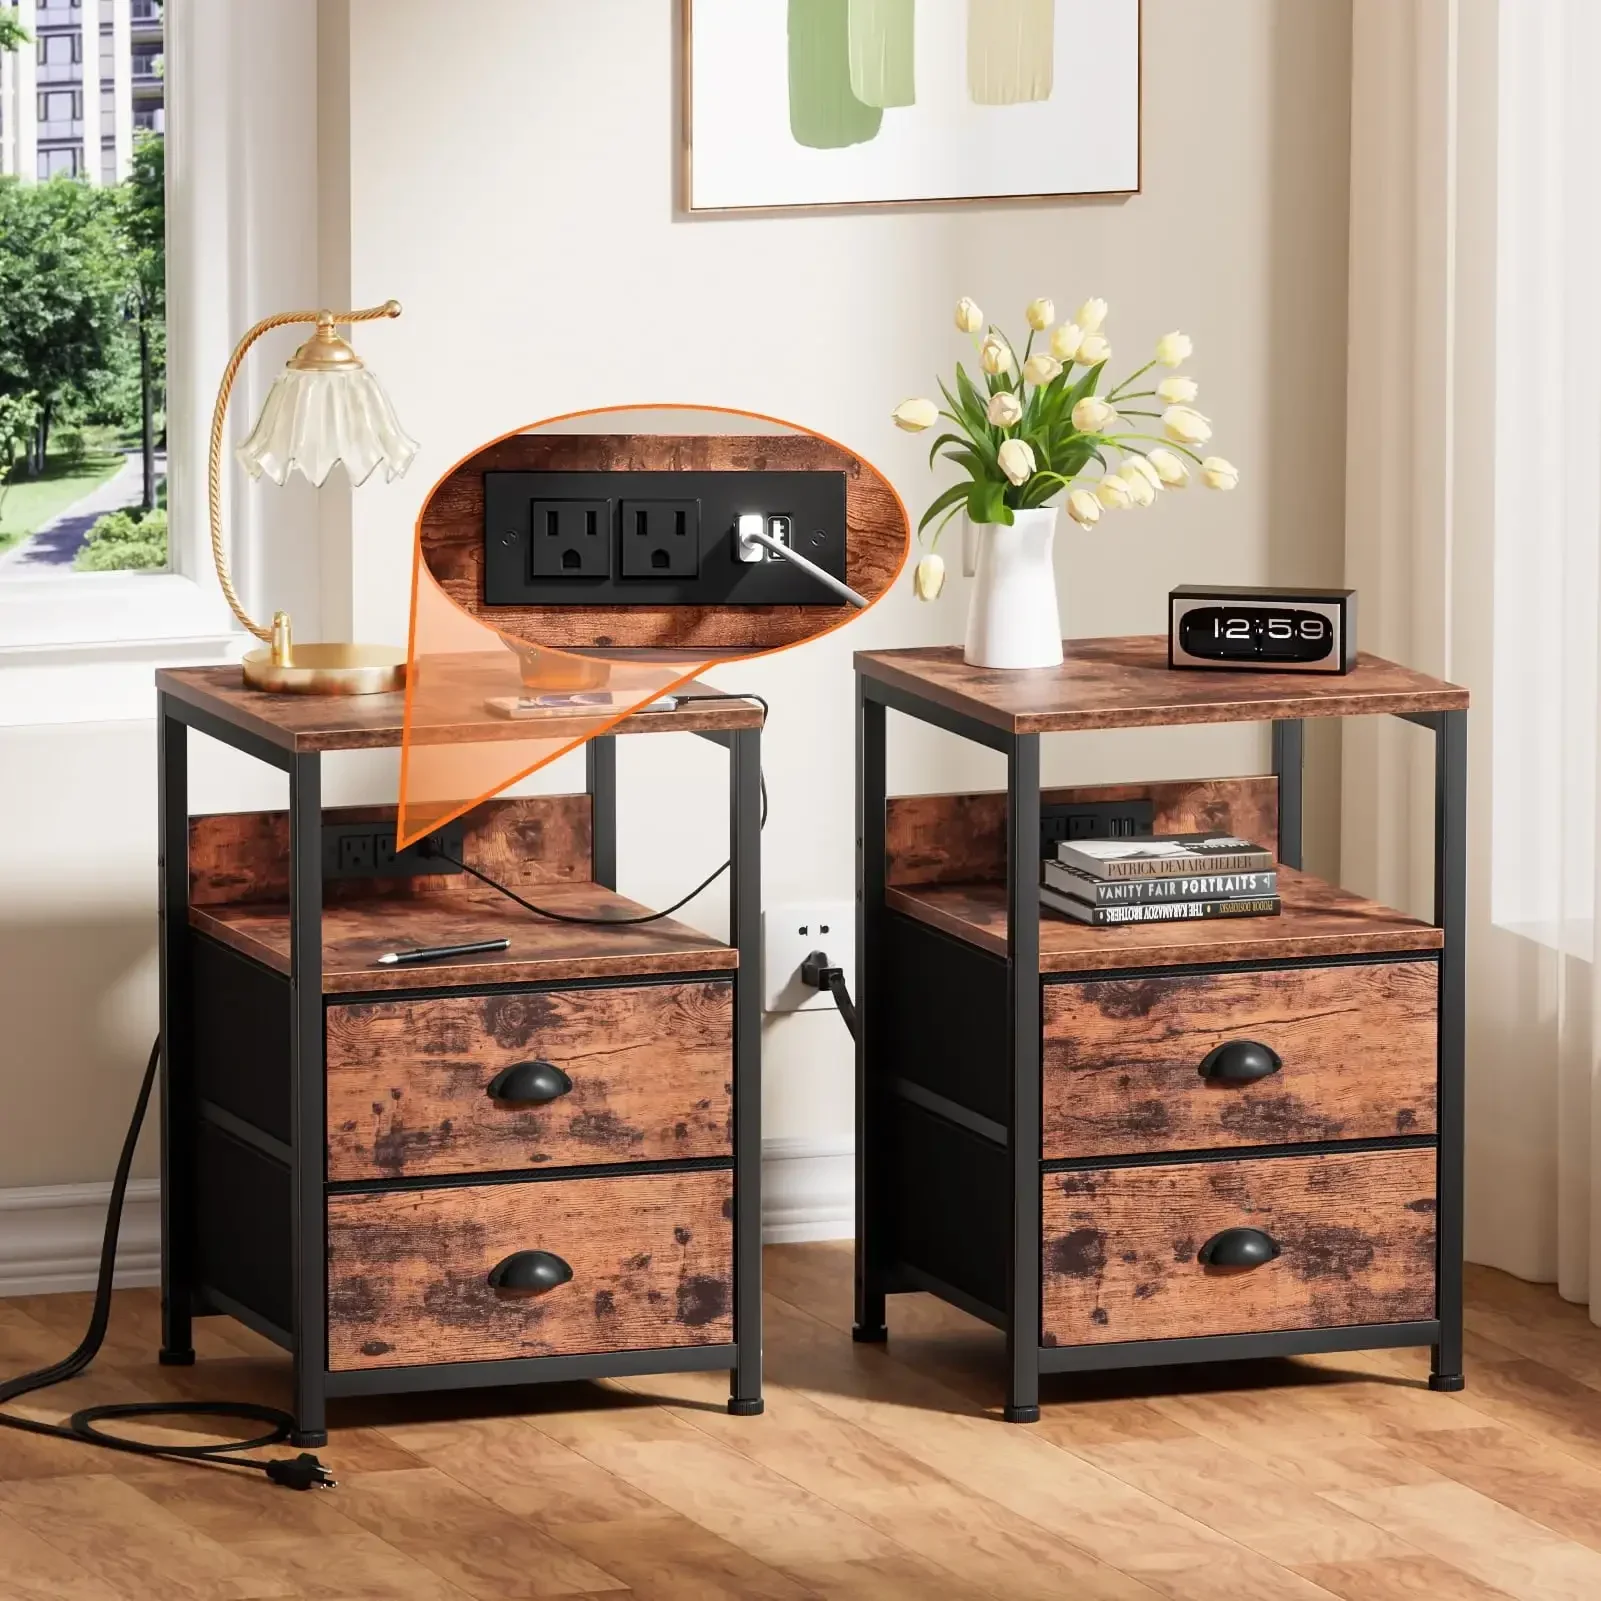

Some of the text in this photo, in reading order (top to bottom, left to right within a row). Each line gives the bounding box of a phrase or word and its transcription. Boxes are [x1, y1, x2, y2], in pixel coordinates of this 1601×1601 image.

[1107, 855, 1252, 877] PATRICK DEMARCHELIER
[1098, 875, 1257, 901] VANITY FAIR PORTRAITS
[1106, 903, 1204, 922] THE KARAMAZOV BROTHERS
